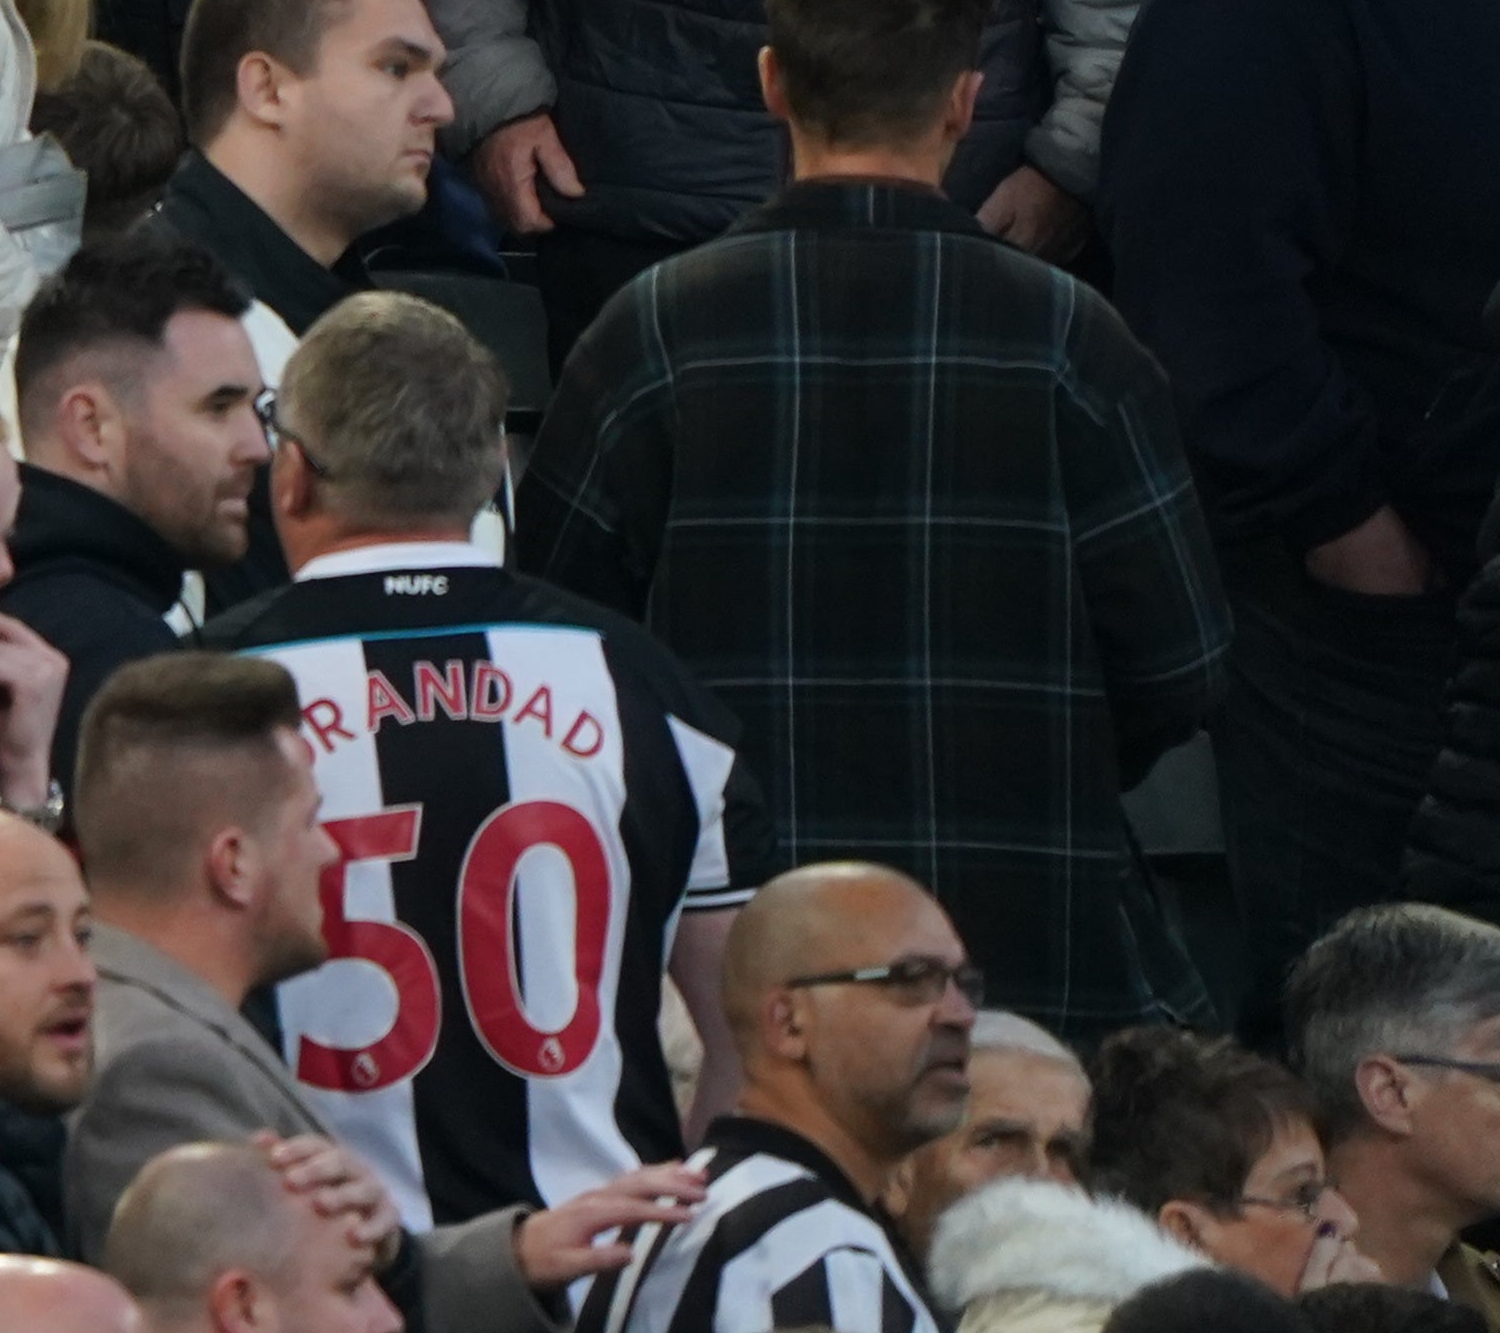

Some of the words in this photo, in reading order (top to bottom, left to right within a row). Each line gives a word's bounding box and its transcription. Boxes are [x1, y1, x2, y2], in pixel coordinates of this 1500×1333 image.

[383, 575, 449, 596] NUFC
[301, 659, 605, 764] RANDAD
[296, 801, 612, 1093] 50
